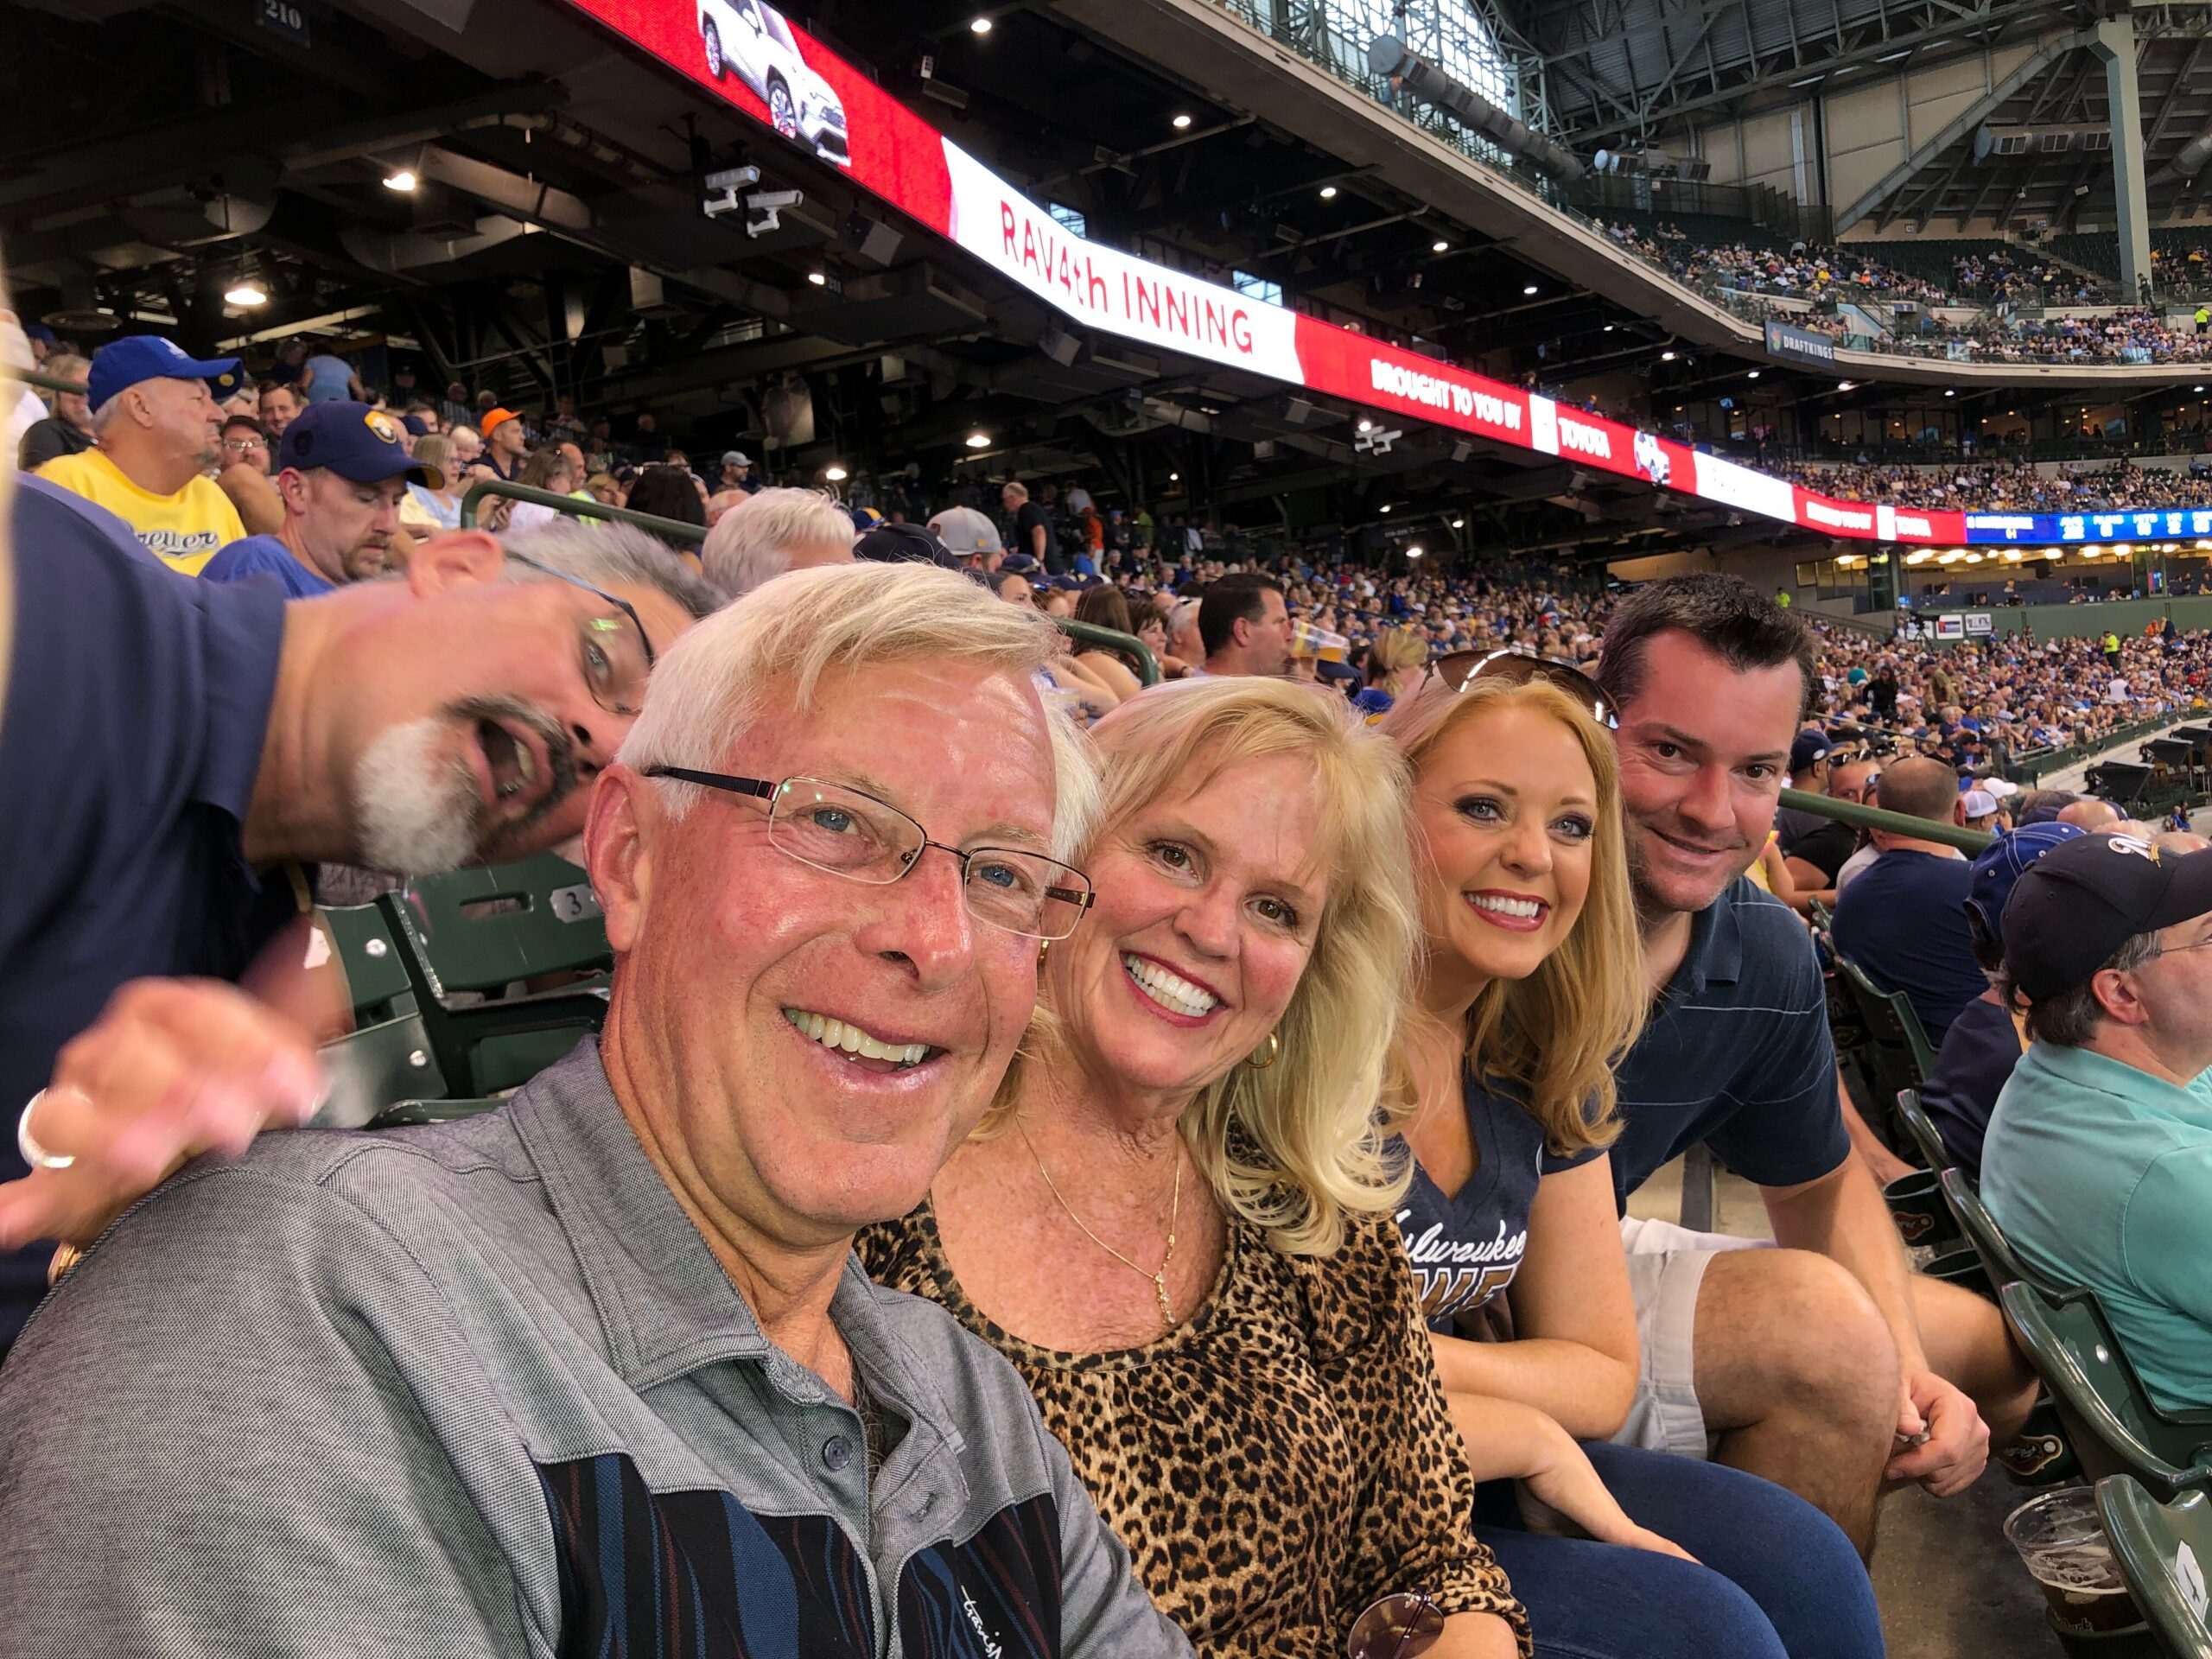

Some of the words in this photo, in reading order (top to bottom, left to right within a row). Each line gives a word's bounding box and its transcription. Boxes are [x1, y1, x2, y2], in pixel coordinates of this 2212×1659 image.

[264, 0, 302, 29] 210
[1000, 200, 1109, 313] RAV4th
[1122, 271, 1253, 355] INNING
[1783, 335, 1833, 359] DRAFTKINGS
[1370, 359, 1450, 410] BROUGHT
[1450, 385, 1473, 416] TO
[1472, 391, 1503, 424] YOU
[1558, 417, 1611, 458] TOYOTA
[566, 892, 582, 916] 3
[1396, 1208, 1528, 1263] ilwaukee
